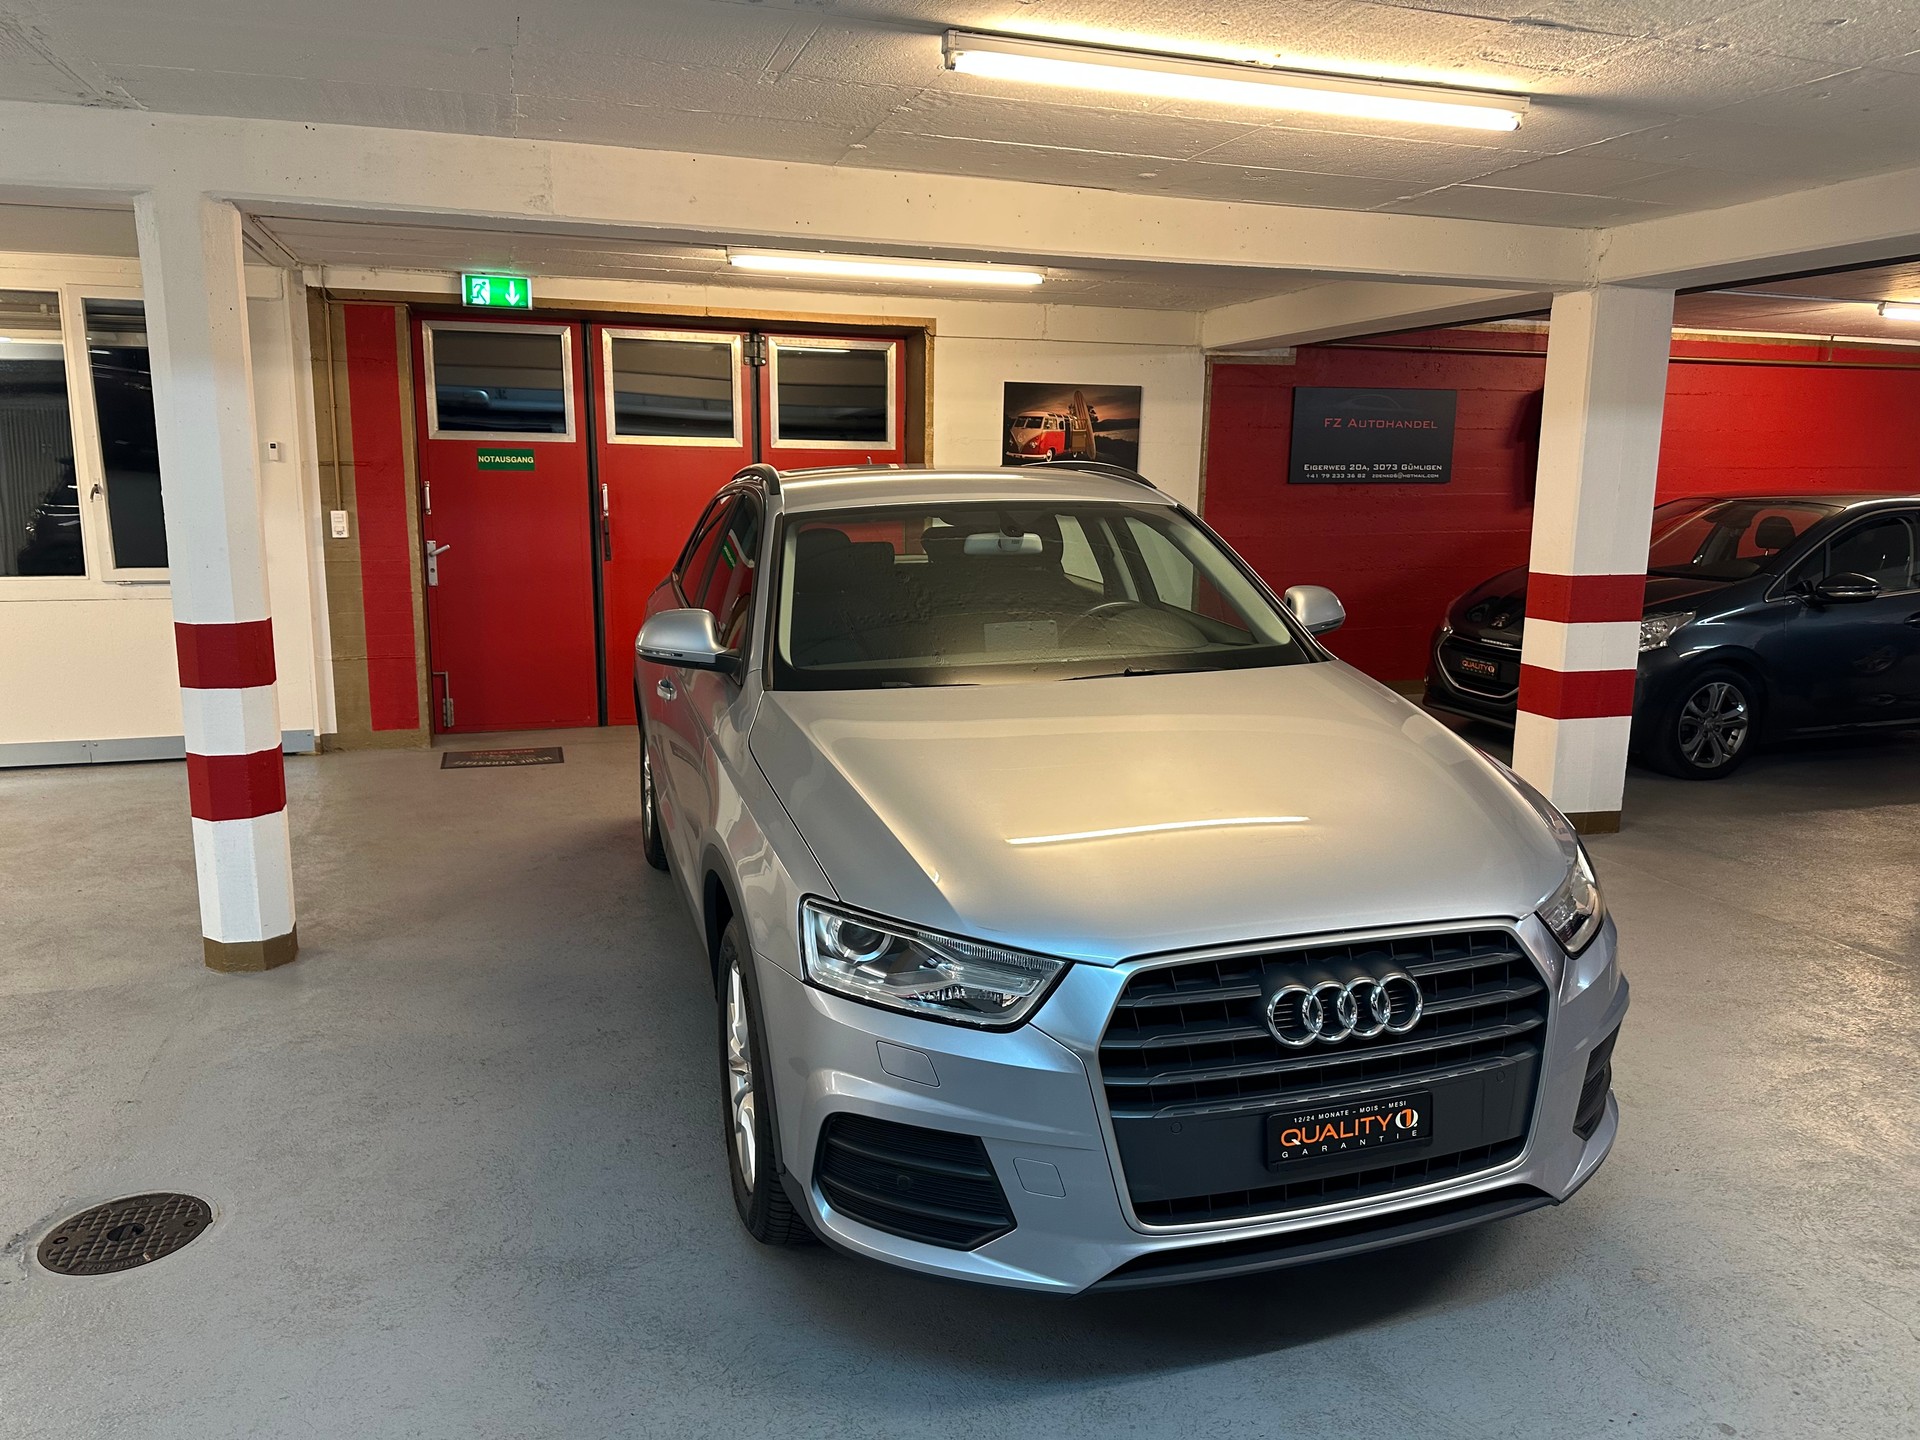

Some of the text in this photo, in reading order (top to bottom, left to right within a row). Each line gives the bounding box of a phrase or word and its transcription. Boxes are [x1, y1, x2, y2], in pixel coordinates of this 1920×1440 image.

[1324, 418, 1342, 428] FZ
[478, 455, 534, 464] NOTAUSGANG
[1373, 463, 1398, 471] 3073
[1462, 660, 1488, 671] QUALITY
[1294, 1114, 1315, 1124] 12/24
[1318, 1110, 1349, 1120] MONATE
[1359, 1105, 1378, 1113] MOIS
[1388, 1100, 1407, 1109] MESI
[1280, 1113, 1393, 1147] QUALITY
[1281, 1129, 1418, 1159] GARANTIE
